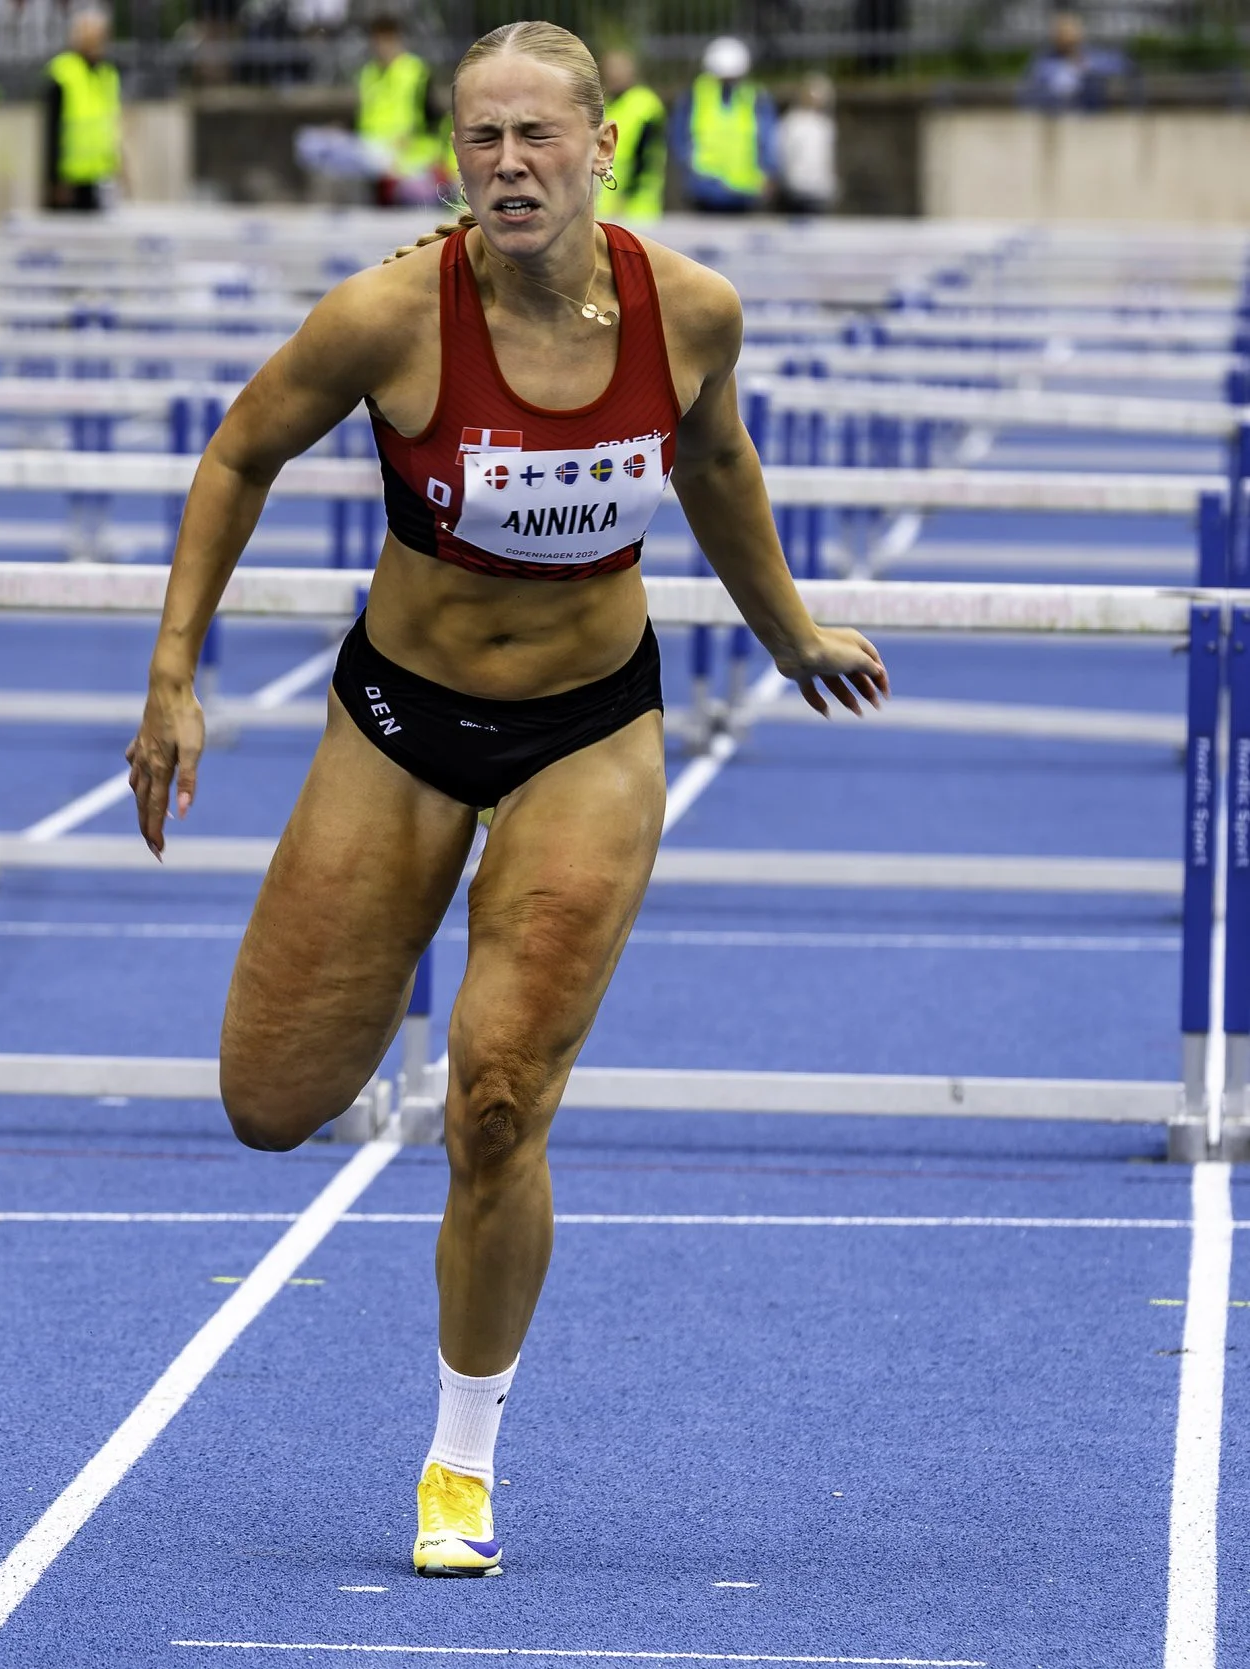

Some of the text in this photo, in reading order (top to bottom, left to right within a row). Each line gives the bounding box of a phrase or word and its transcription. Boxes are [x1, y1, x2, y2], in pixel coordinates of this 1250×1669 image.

[500, 502, 617, 537] ANNIKA
[505, 547, 599, 559] COPENHAGEN 2026
[365, 686, 402, 736] DEN
